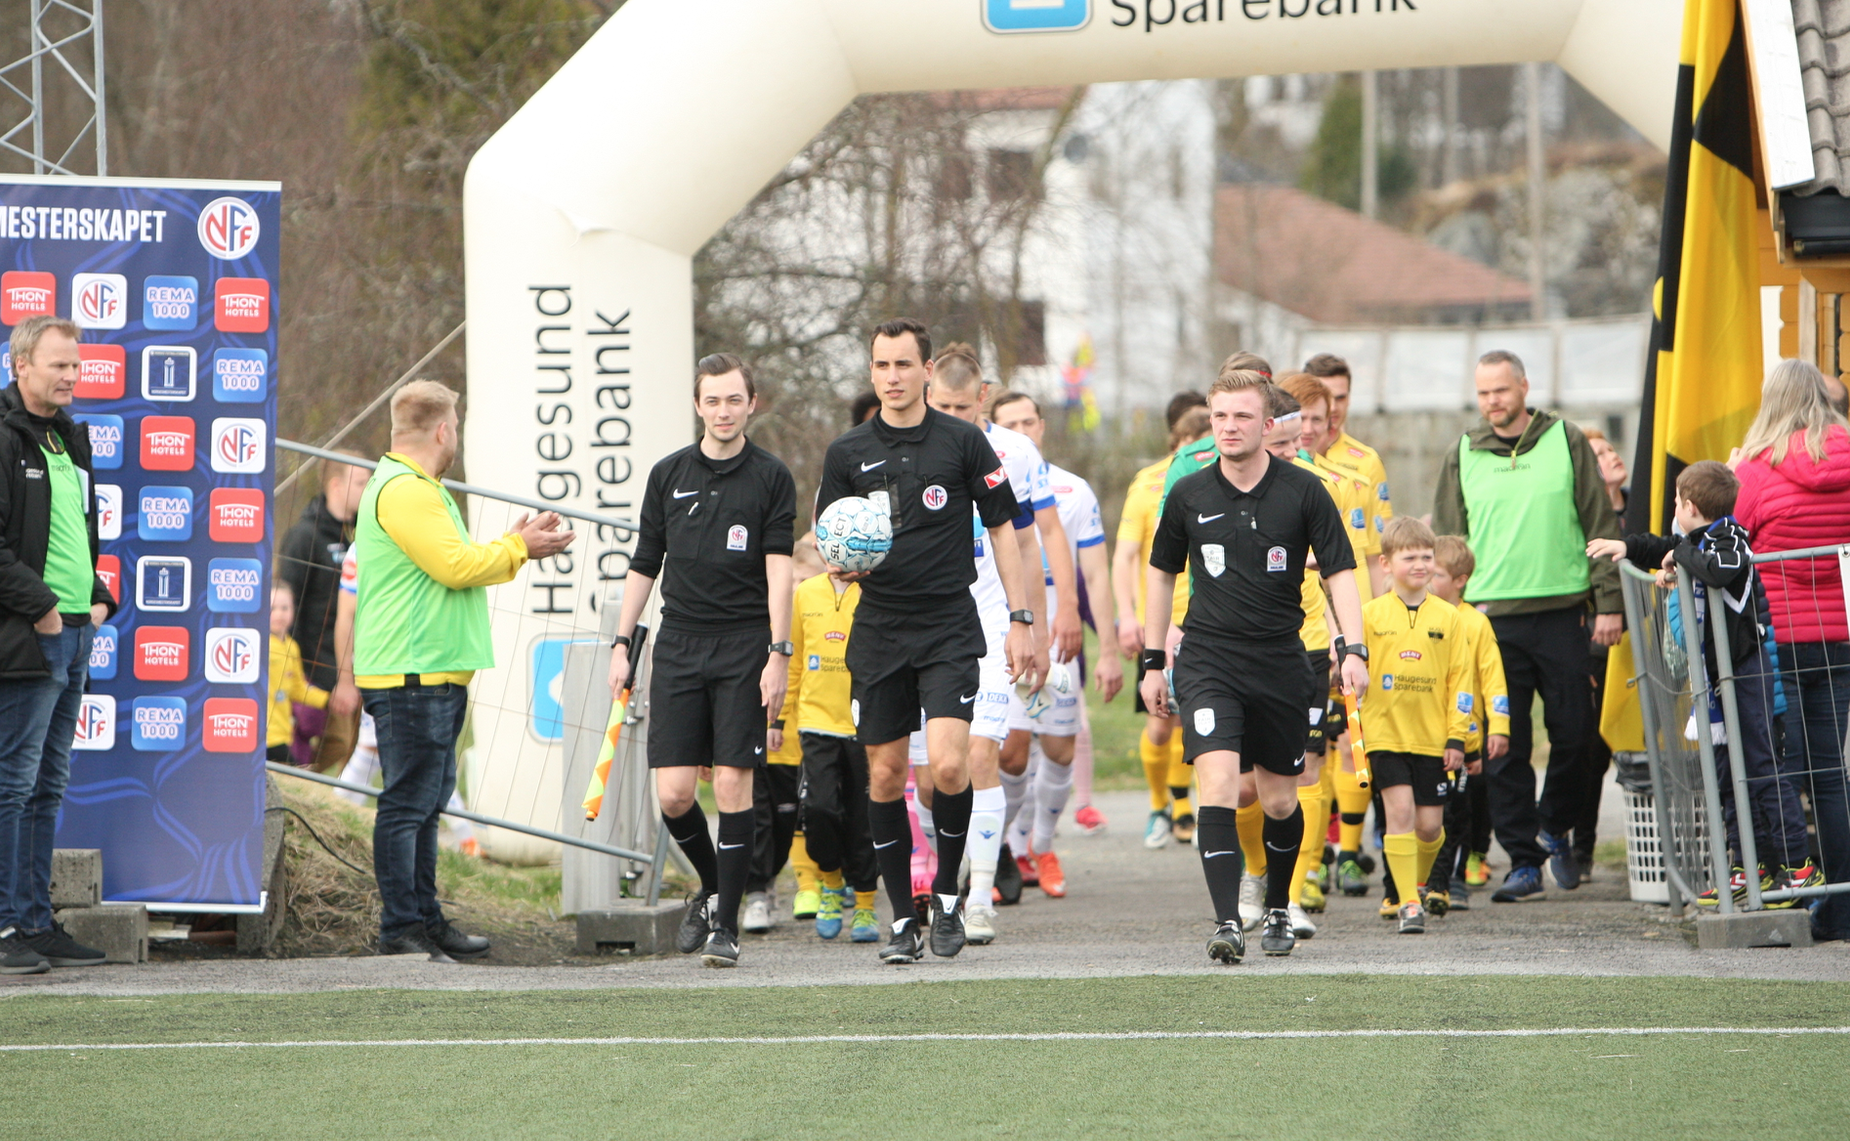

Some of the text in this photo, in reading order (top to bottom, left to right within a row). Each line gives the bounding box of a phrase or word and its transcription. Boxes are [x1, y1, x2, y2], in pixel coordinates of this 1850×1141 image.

[6, 287, 51, 302] THON
[148, 288, 194, 303] REMA
[220, 293, 265, 308] THON
[11, 302, 46, 312] HOTELS
[153, 305, 188, 317] 1000
[225, 308, 259, 318] HOTELS
[80, 359, 121, 374] THON
[218, 361, 263, 375] REMA
[81, 375, 115, 384] HOTELS
[222, 376, 258, 390] 1000
[88, 425, 120, 440] EMA
[145, 431, 190, 446] THON
[92, 442, 115, 456] 00
[150, 446, 185, 456] HOTELS
[528, 286, 581, 613] Hagesund
[143, 499, 189, 512] REMA
[215, 503, 260, 518] THON
[148, 514, 184, 528] 1000
[220, 518, 254, 527] HOTELS
[212, 571, 258, 584] REMA
[217, 586, 253, 599] 1000
[93, 637, 114, 651] MA
[140, 641, 184, 656] THON
[90, 653, 108, 666] 00
[144, 656, 179, 666] HOTELS
[136, 709, 182, 722] REMA
[208, 713, 253, 728] THON
[141, 724, 177, 738] 1000
[213, 728, 248, 738] HOTELS
